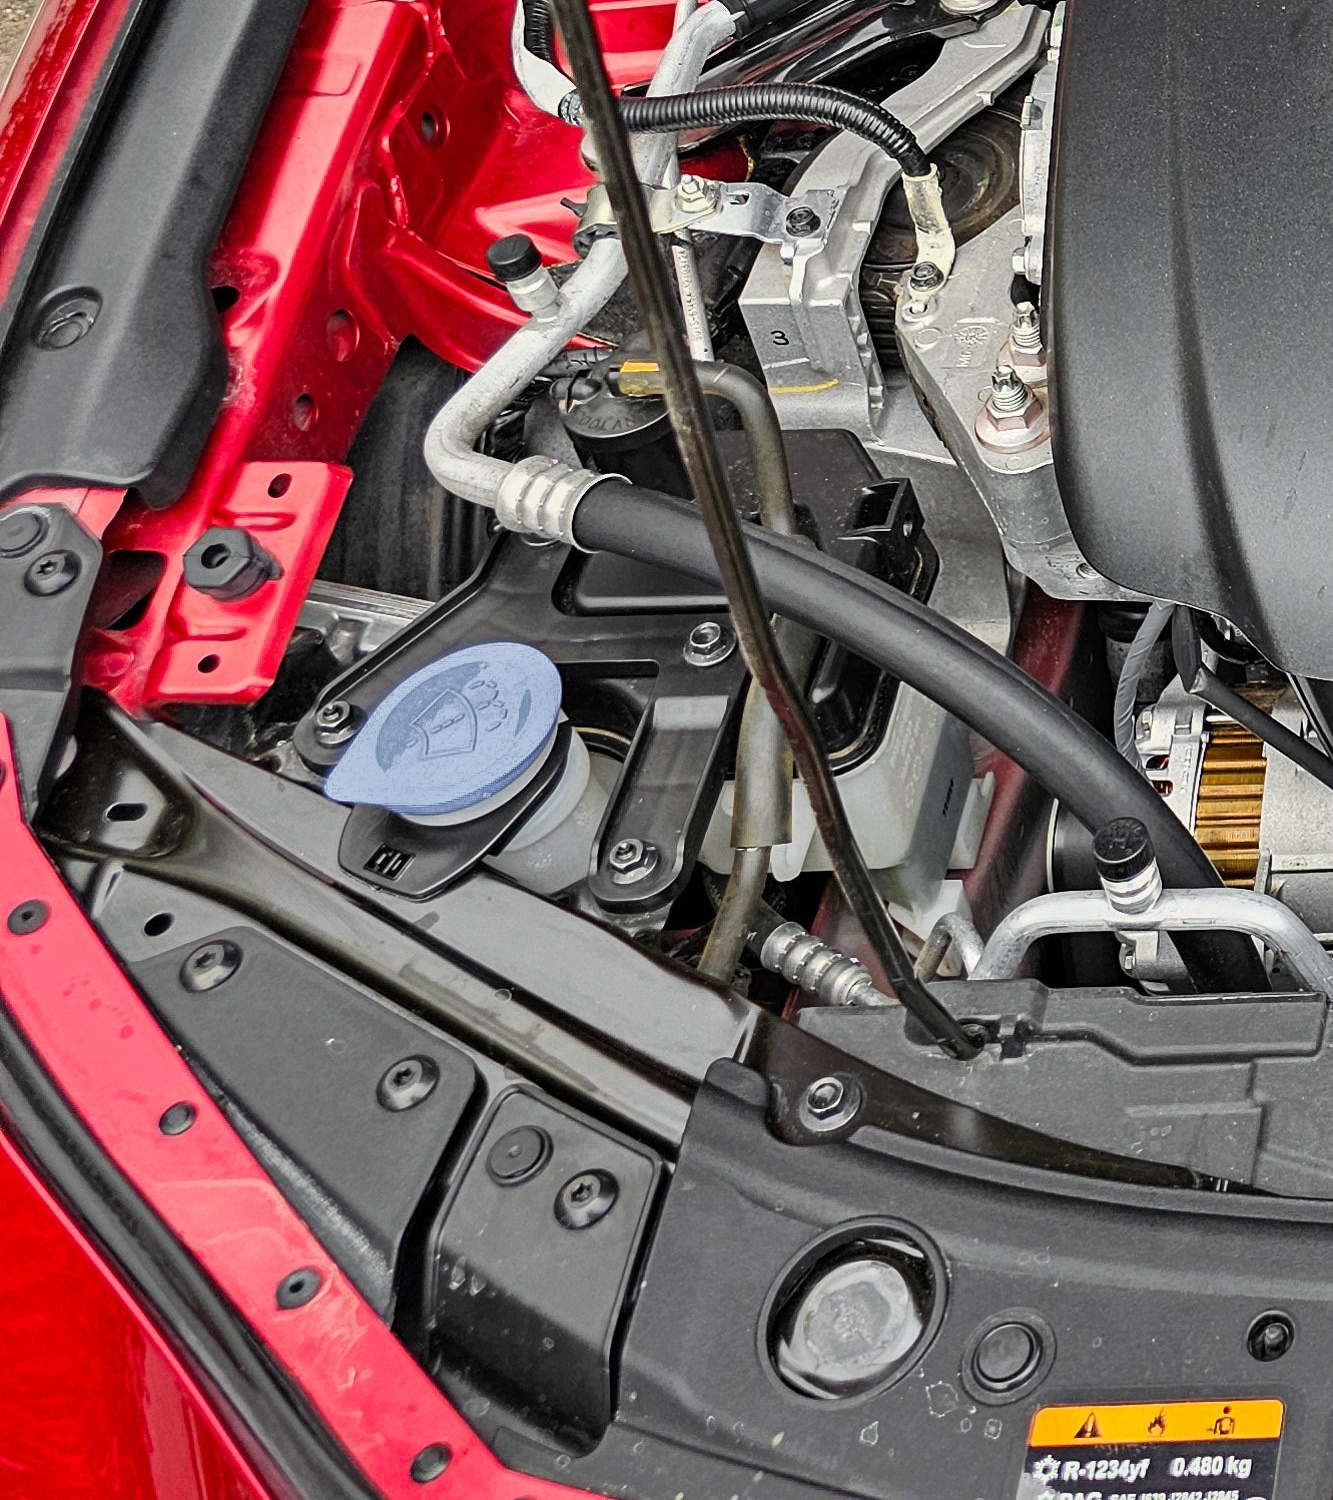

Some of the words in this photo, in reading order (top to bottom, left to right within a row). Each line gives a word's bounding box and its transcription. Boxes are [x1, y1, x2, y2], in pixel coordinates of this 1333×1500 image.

[770, 329, 790, 346] 3
[1063, 1458, 1150, 1482] R-1234yf
[1170, 1456, 1222, 1479] 0.480
[1225, 1455, 1253, 1479] kg
